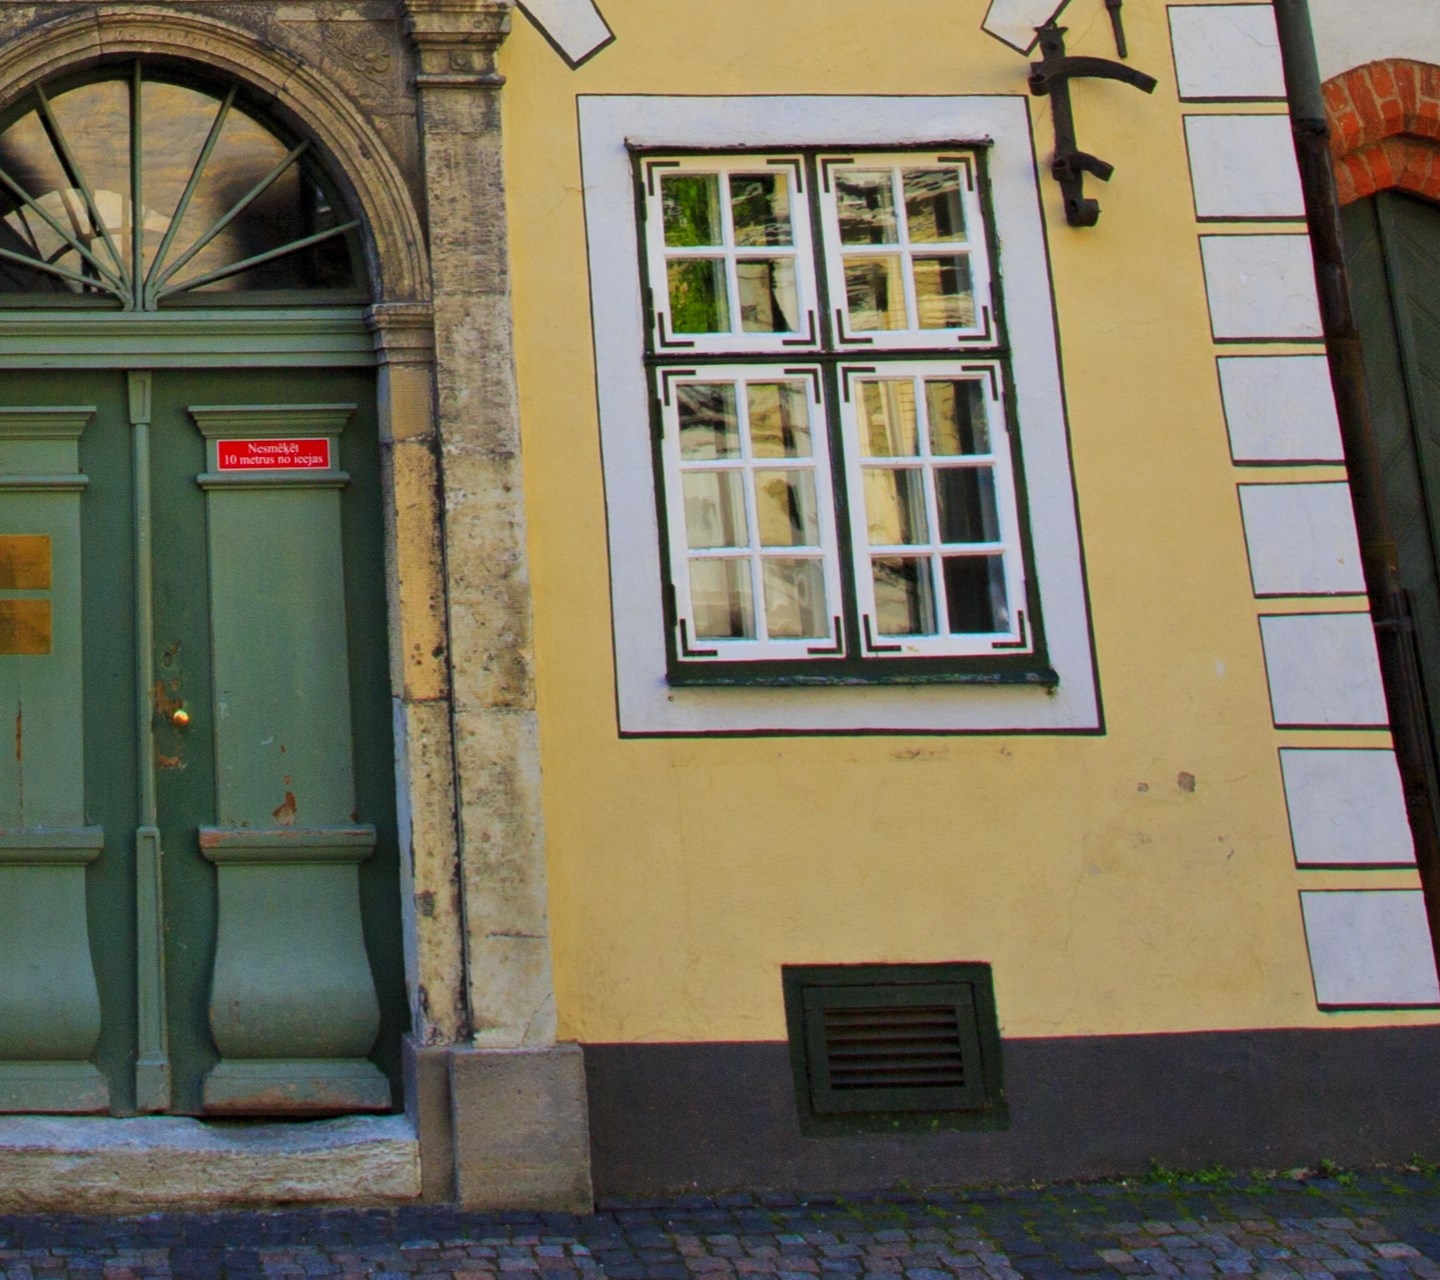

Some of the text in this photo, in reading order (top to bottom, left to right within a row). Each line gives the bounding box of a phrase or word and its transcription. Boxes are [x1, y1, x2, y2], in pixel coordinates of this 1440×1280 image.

[247, 443, 300, 455] Nesmēķēt
[224, 453, 324, 467] 10 metrus no ieejas
